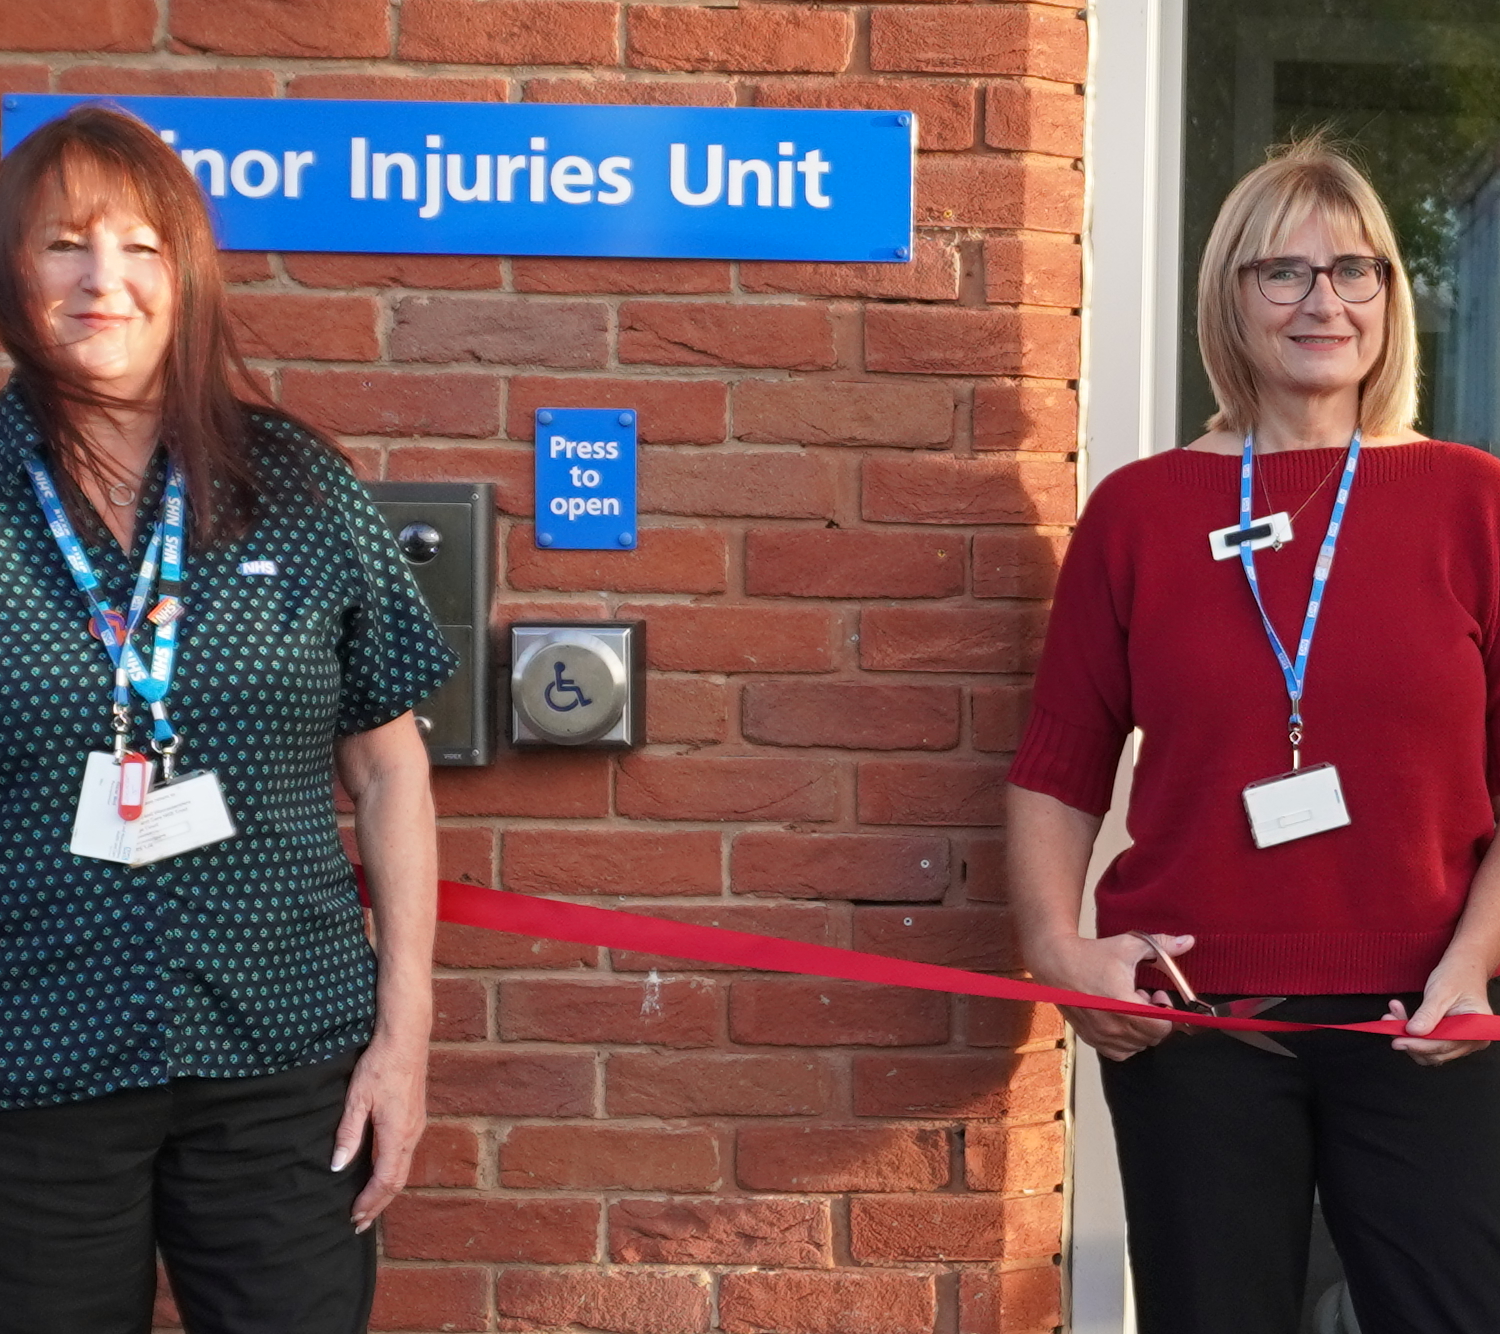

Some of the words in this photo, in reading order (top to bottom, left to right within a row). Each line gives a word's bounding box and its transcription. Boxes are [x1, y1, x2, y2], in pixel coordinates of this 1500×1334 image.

[160, 130, 314, 198] nor
[350, 133, 632, 218] Injuries
[669, 142, 832, 209] Unit
[550, 436, 618, 459] Press
[569, 466, 600, 487] to
[166, 495, 180, 526] NHS
[550, 496, 620, 520] open
[164, 535, 179, 564] NHS
[243, 561, 277, 575] NHS
[156, 603, 178, 624] NHS
[151, 647, 169, 681] NHS
